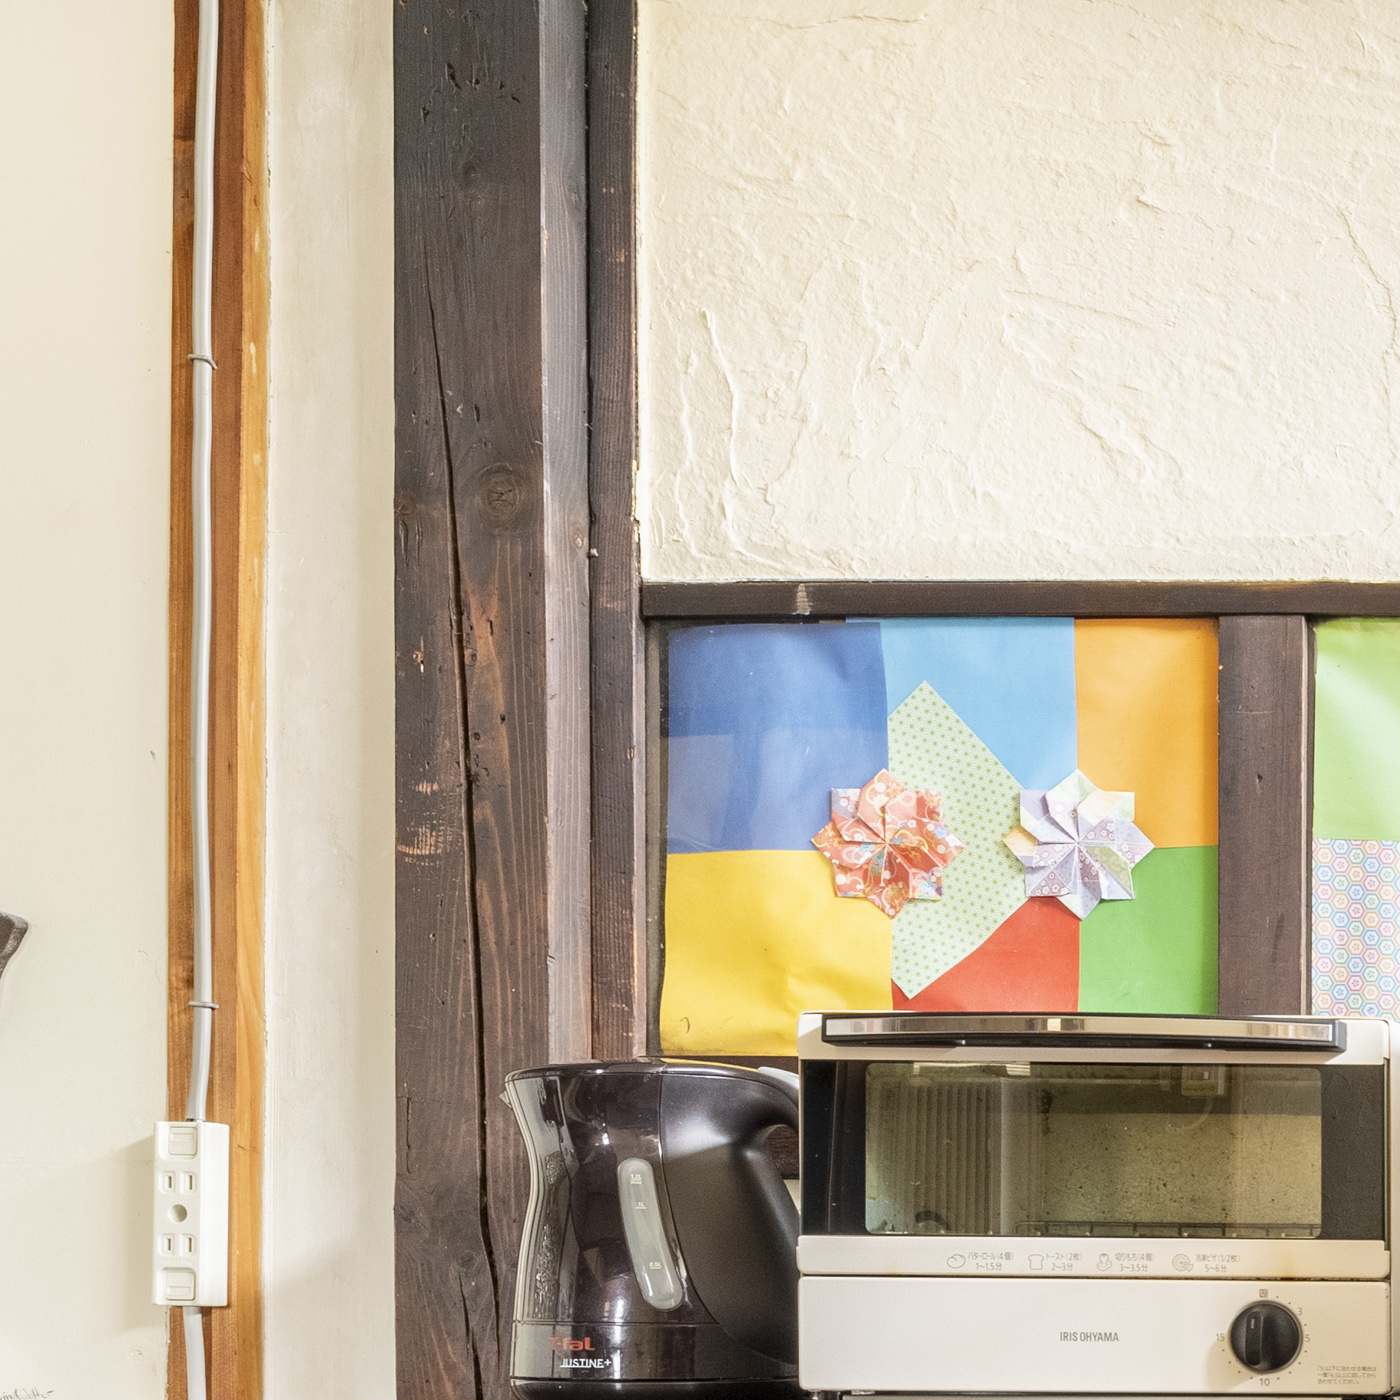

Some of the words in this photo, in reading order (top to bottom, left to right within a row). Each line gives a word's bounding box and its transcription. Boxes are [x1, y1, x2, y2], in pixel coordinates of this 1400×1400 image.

[1297, 1306, 1303, 1316] 3
[1060, 1331, 1078, 1342] IRIS
[1080, 1332, 1120, 1342] OHYAMA
[1216, 1333, 1226, 1342] 15
[1305, 1334, 1311, 1343] 5
[1259, 1378, 1270, 1387] 10
